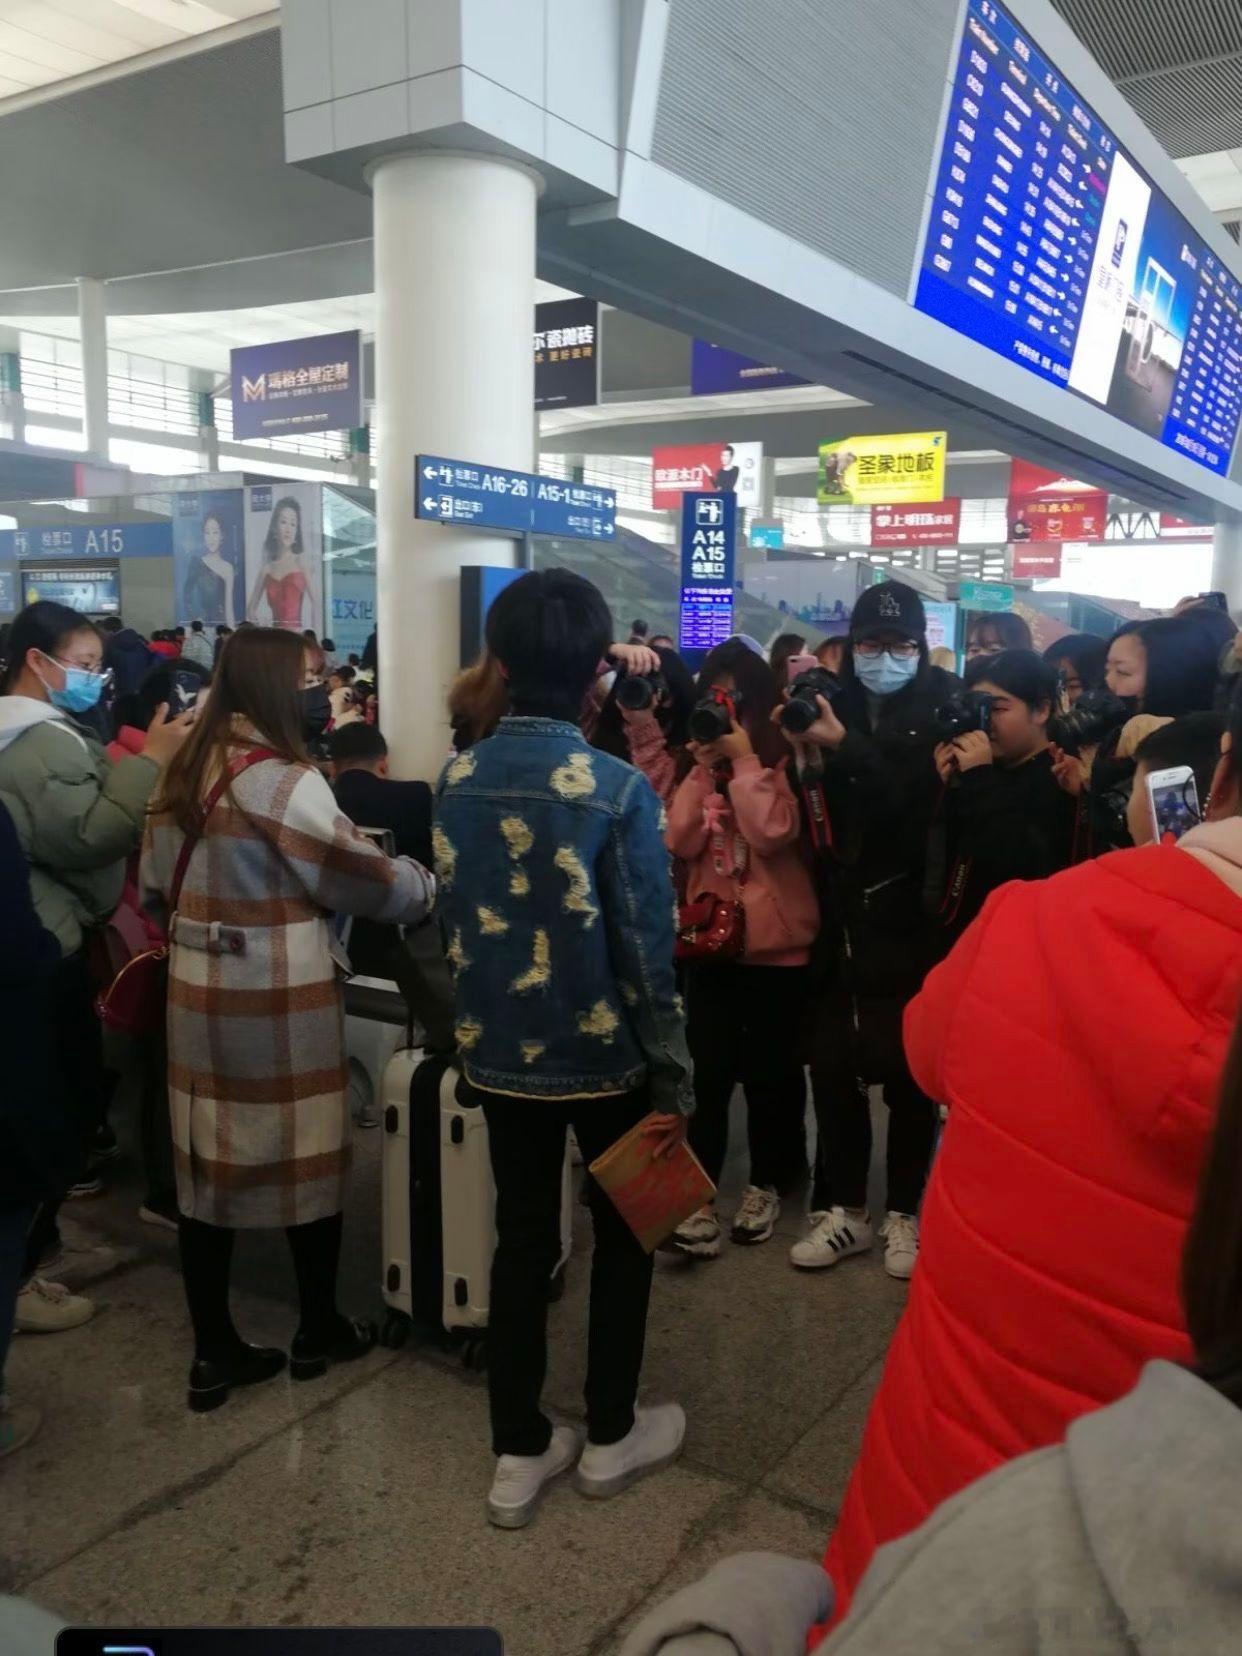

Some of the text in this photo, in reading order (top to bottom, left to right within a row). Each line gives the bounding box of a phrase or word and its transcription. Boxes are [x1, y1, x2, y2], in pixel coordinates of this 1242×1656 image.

[858, 452, 935, 475] 圣象地板
[481, 474, 528, 497] A16-26
[538, 483, 570, 504] A15-1
[84, 529, 124, 553] A15
[692, 530, 725, 545] A14
[692, 546, 725, 561] A15
